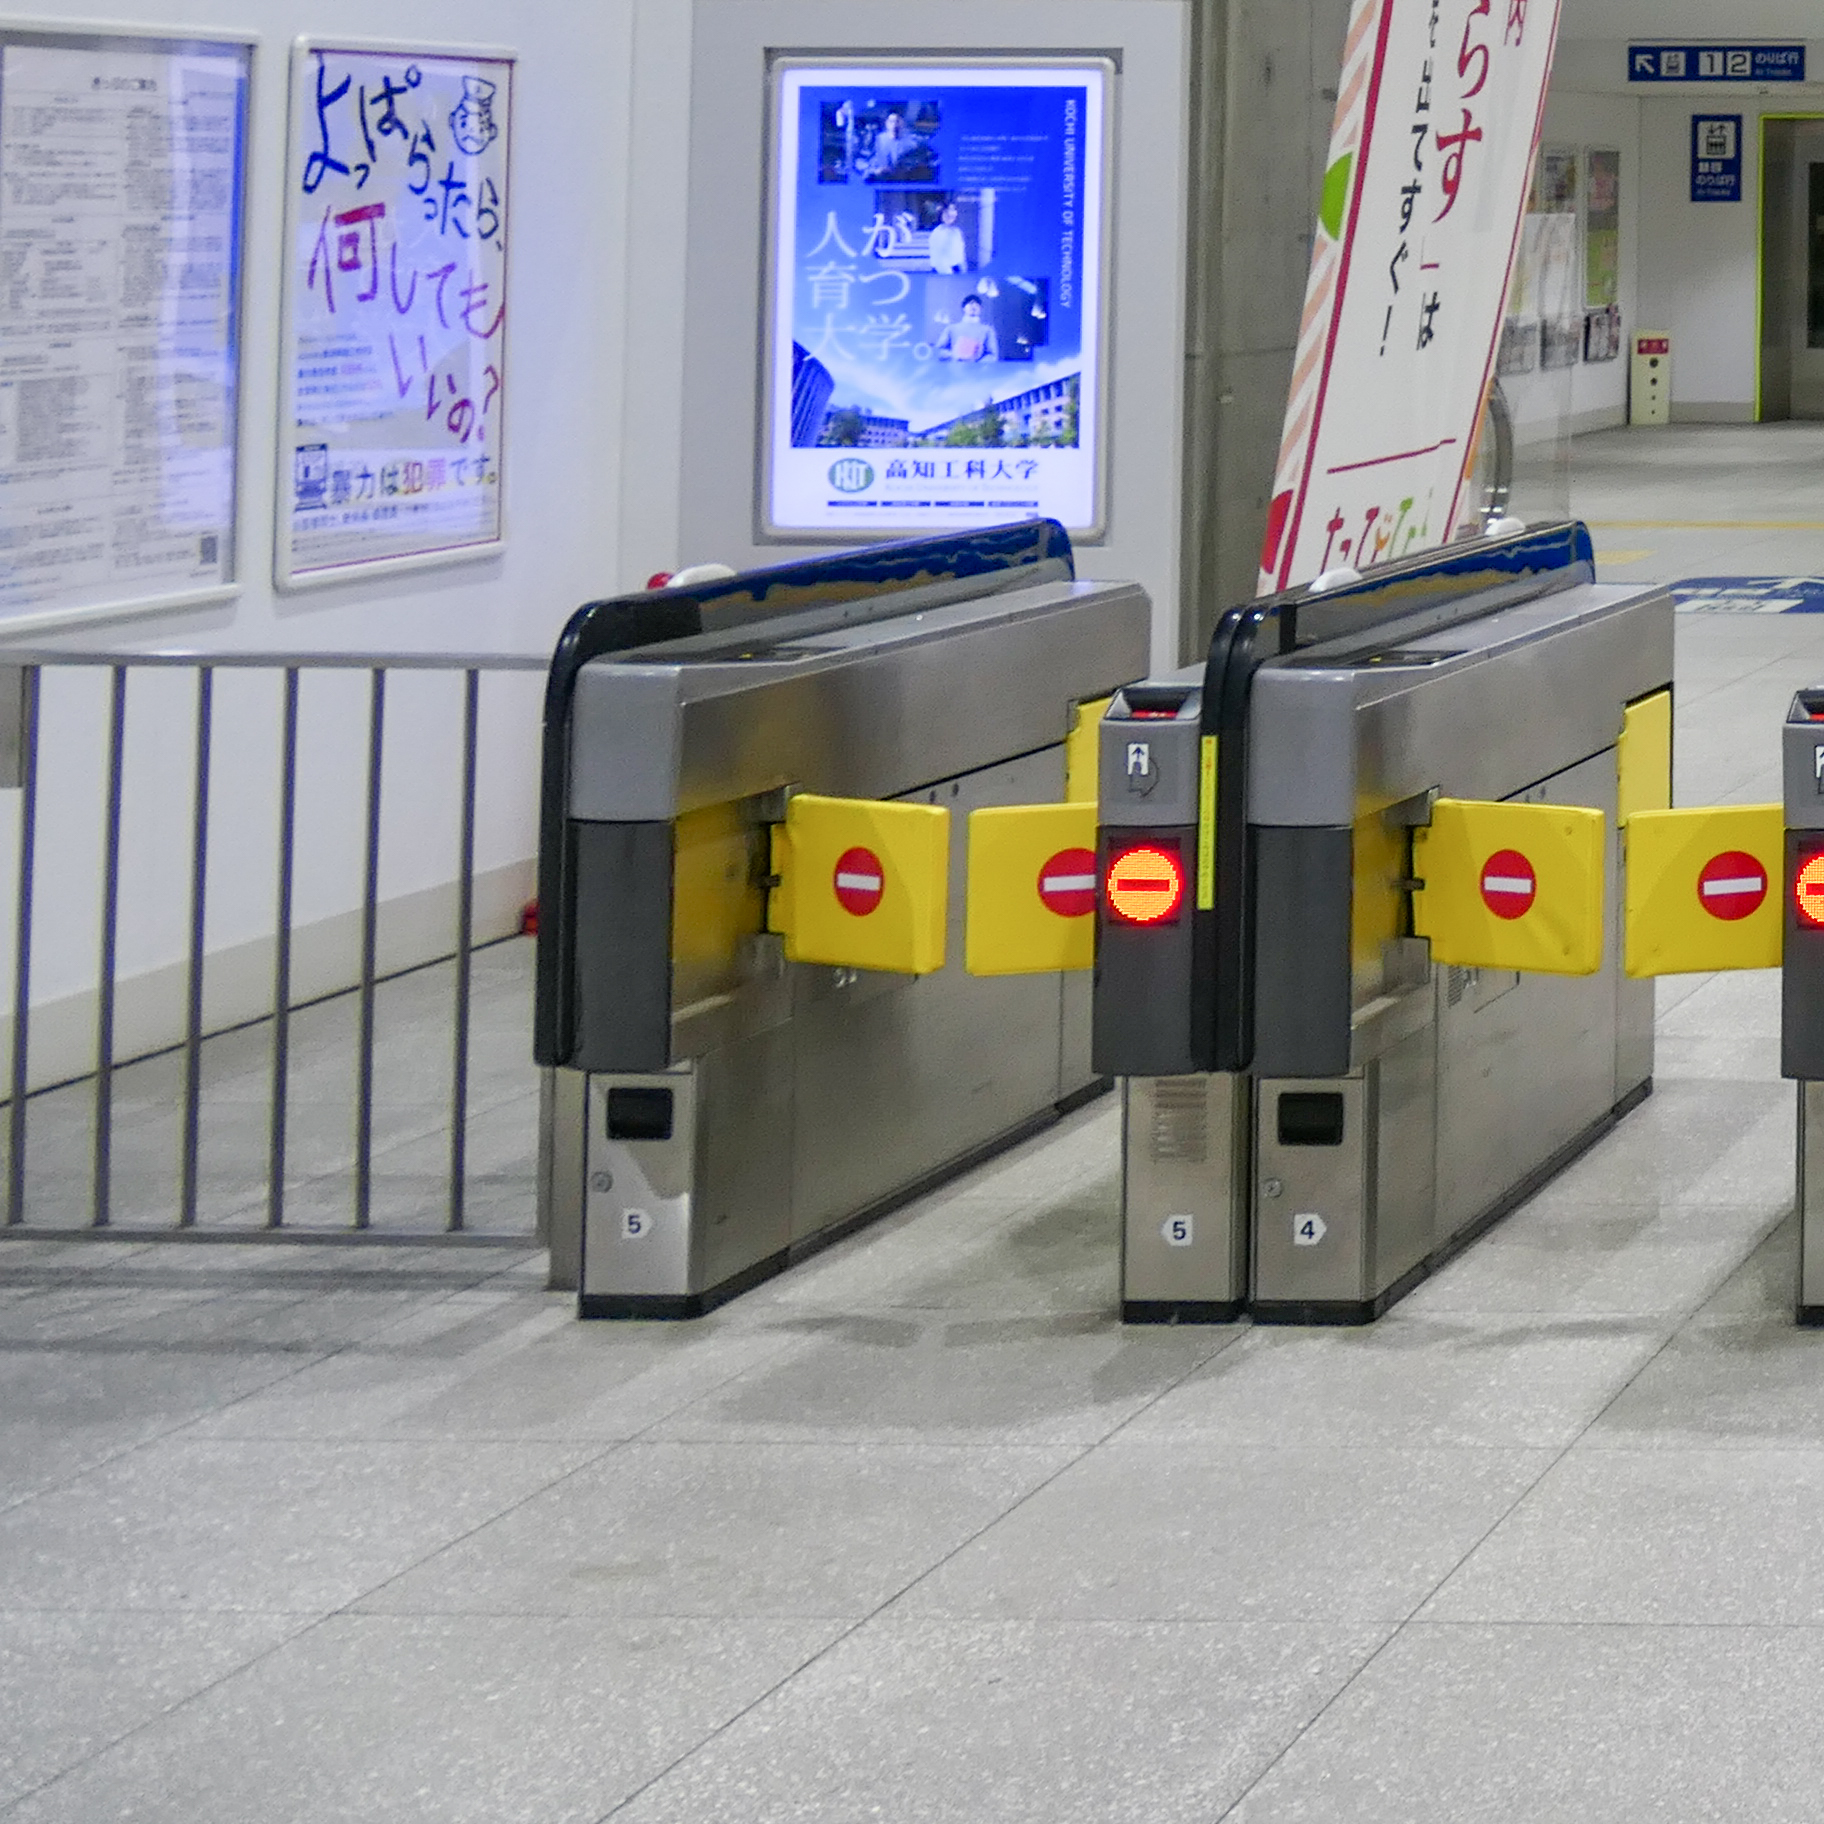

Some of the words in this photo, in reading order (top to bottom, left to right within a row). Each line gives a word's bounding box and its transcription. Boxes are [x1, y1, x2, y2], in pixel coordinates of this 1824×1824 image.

[1707, 54, 1714, 73] 1
[1731, 53, 1747, 73] 2
[1063, 138, 1075, 207] UNIVERSITY
[806, 211, 913, 258] 人が
[805, 261, 911, 309] 育つ
[1060, 230, 1073, 308] TECHNOLOGY
[801, 313, 932, 361] 大学。
[886, 459, 1038, 480] 高知工科大学
[627, 1214, 641, 1235] 5
[1172, 1221, 1187, 1241] 5
[1300, 1221, 1315, 1240] 4
